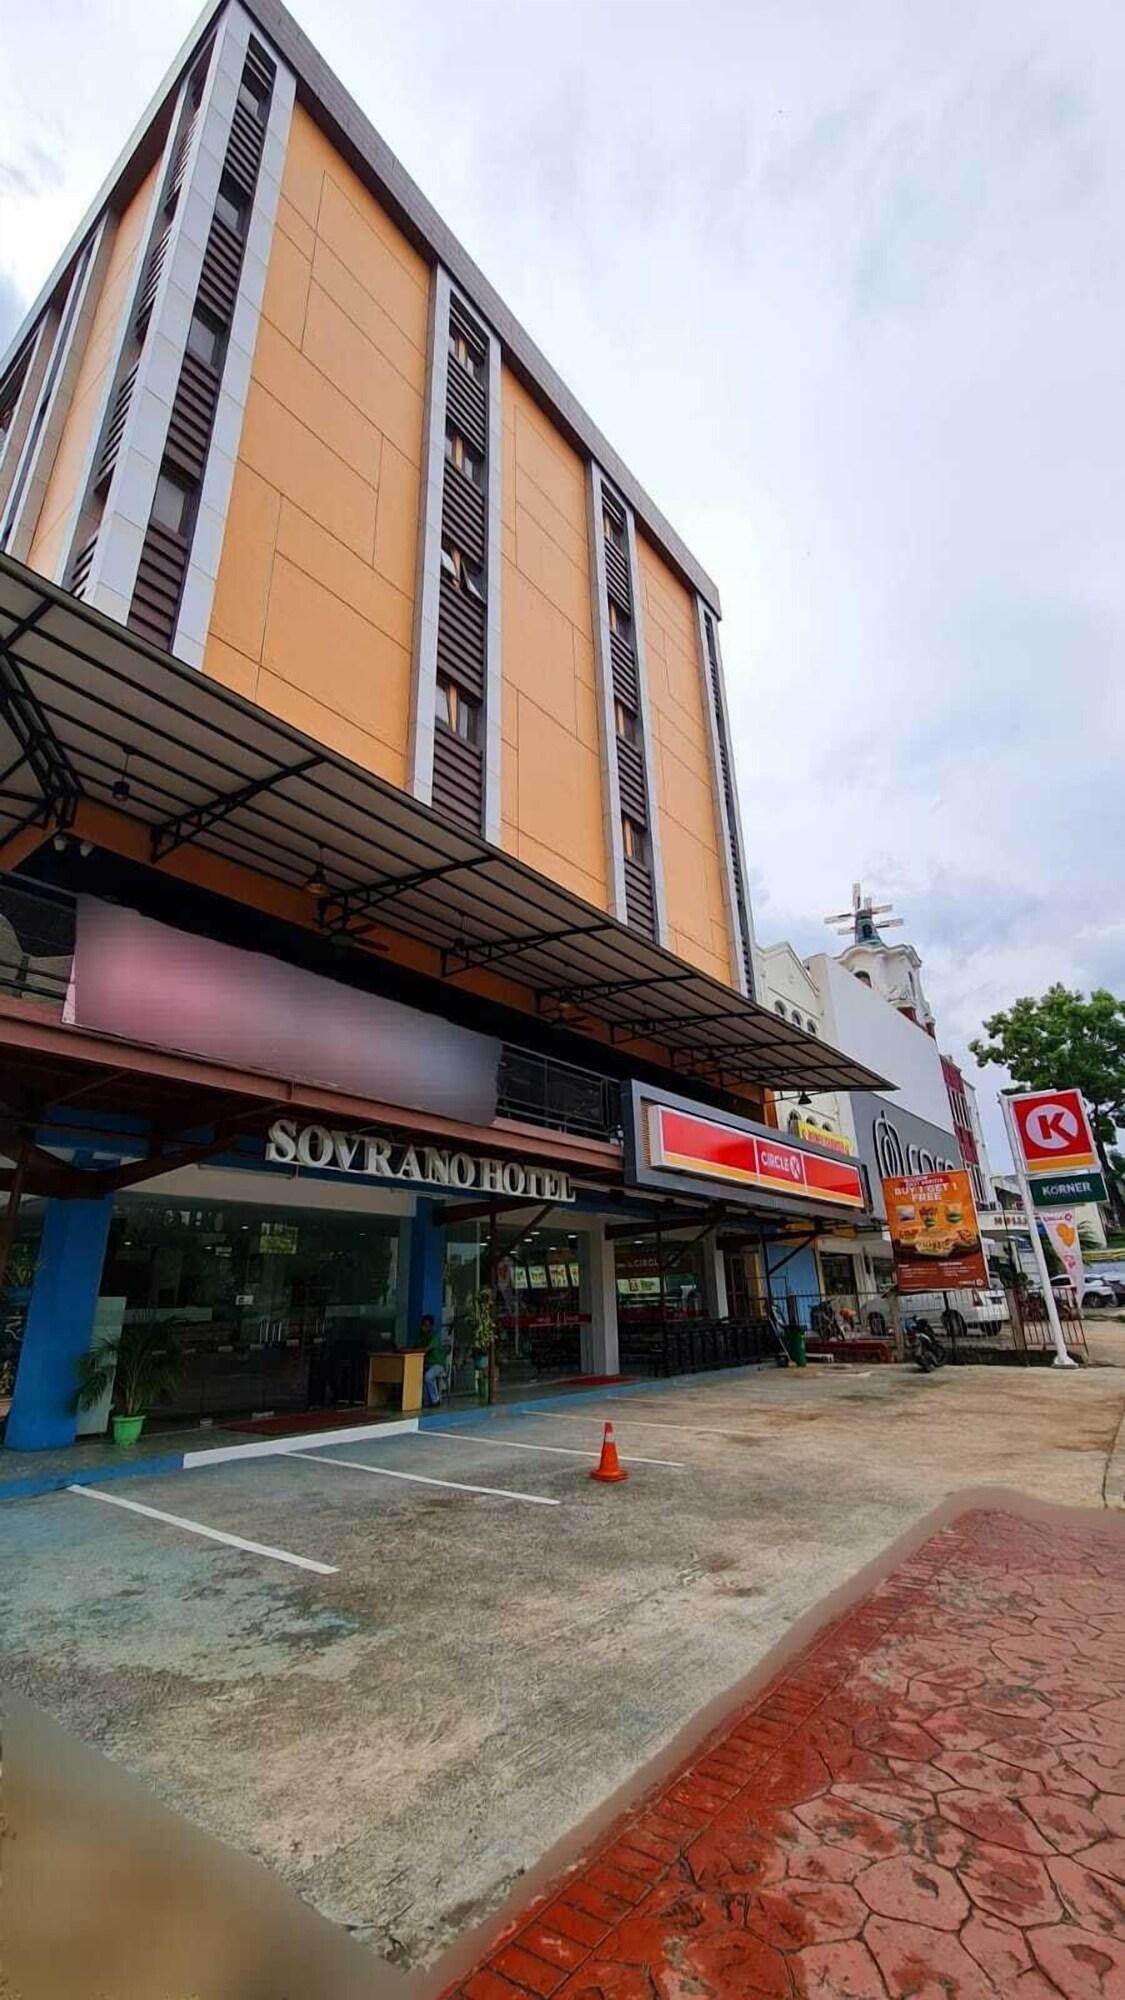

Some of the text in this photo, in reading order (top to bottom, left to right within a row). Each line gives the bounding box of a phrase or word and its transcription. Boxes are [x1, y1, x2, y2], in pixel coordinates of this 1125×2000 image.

[1036, 1110, 1078, 1143] K
[266, 1118, 576, 1202] SOVRANO HOTEL
[761, 1151, 790, 1172] CIRCLE
[894, 1186, 915, 1196] BUY
[927, 1182, 948, 1193] GET
[911, 1192, 942, 1201] FREE
[1041, 1181, 1092, 1197] KORNER
